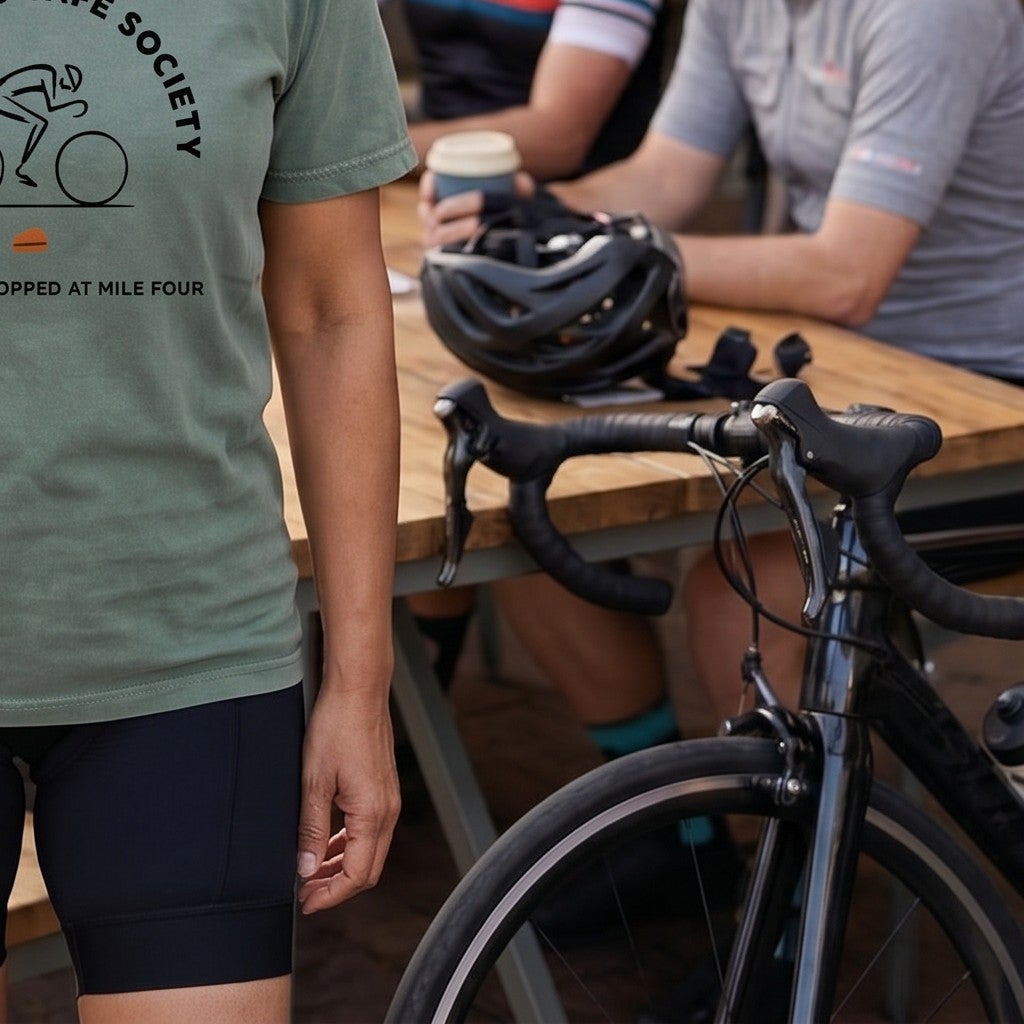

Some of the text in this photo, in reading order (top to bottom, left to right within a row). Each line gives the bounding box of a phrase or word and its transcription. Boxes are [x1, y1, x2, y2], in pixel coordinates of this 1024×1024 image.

[117, 11, 201, 159] SOCIETY
[68, 280, 93, 296] AT
[98, 280, 145, 296] MILE
[151, 280, 205, 296] FOUR
